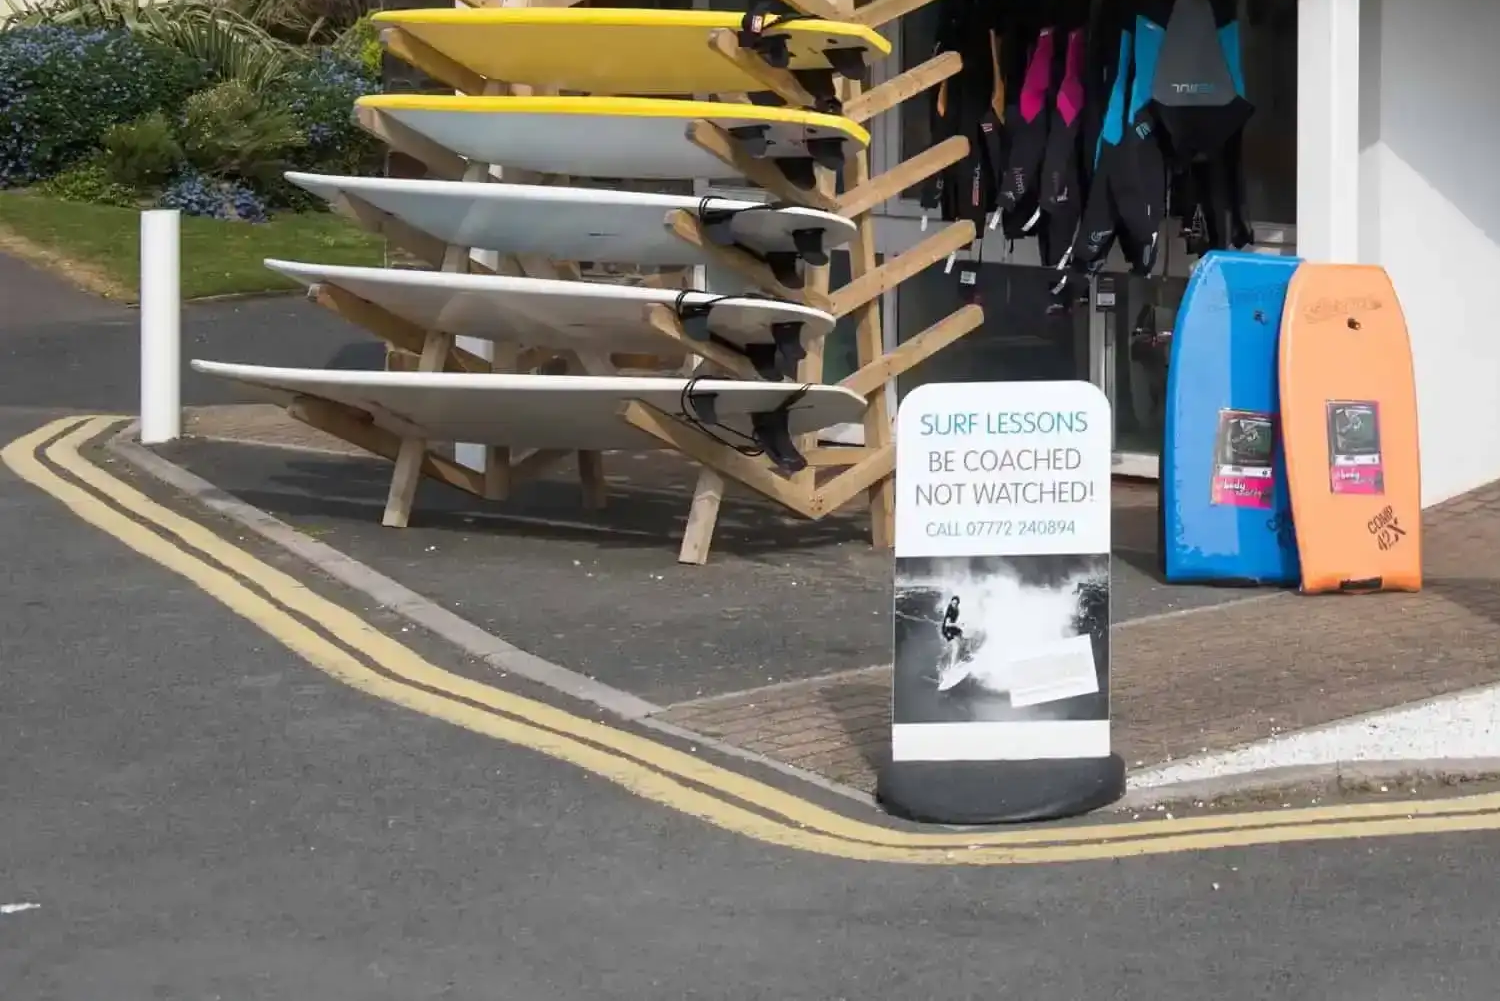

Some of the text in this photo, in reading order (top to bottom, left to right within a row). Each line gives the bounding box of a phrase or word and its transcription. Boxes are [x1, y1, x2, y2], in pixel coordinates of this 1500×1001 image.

[920, 411, 1089, 436] SURF LESSONS
[928, 447, 1082, 473] BE COACHED
[915, 480, 1095, 506] NOT WATCHED!
[925, 520, 1076, 537] CALL 07772 240894
[1367, 504, 1393, 535] COMP
